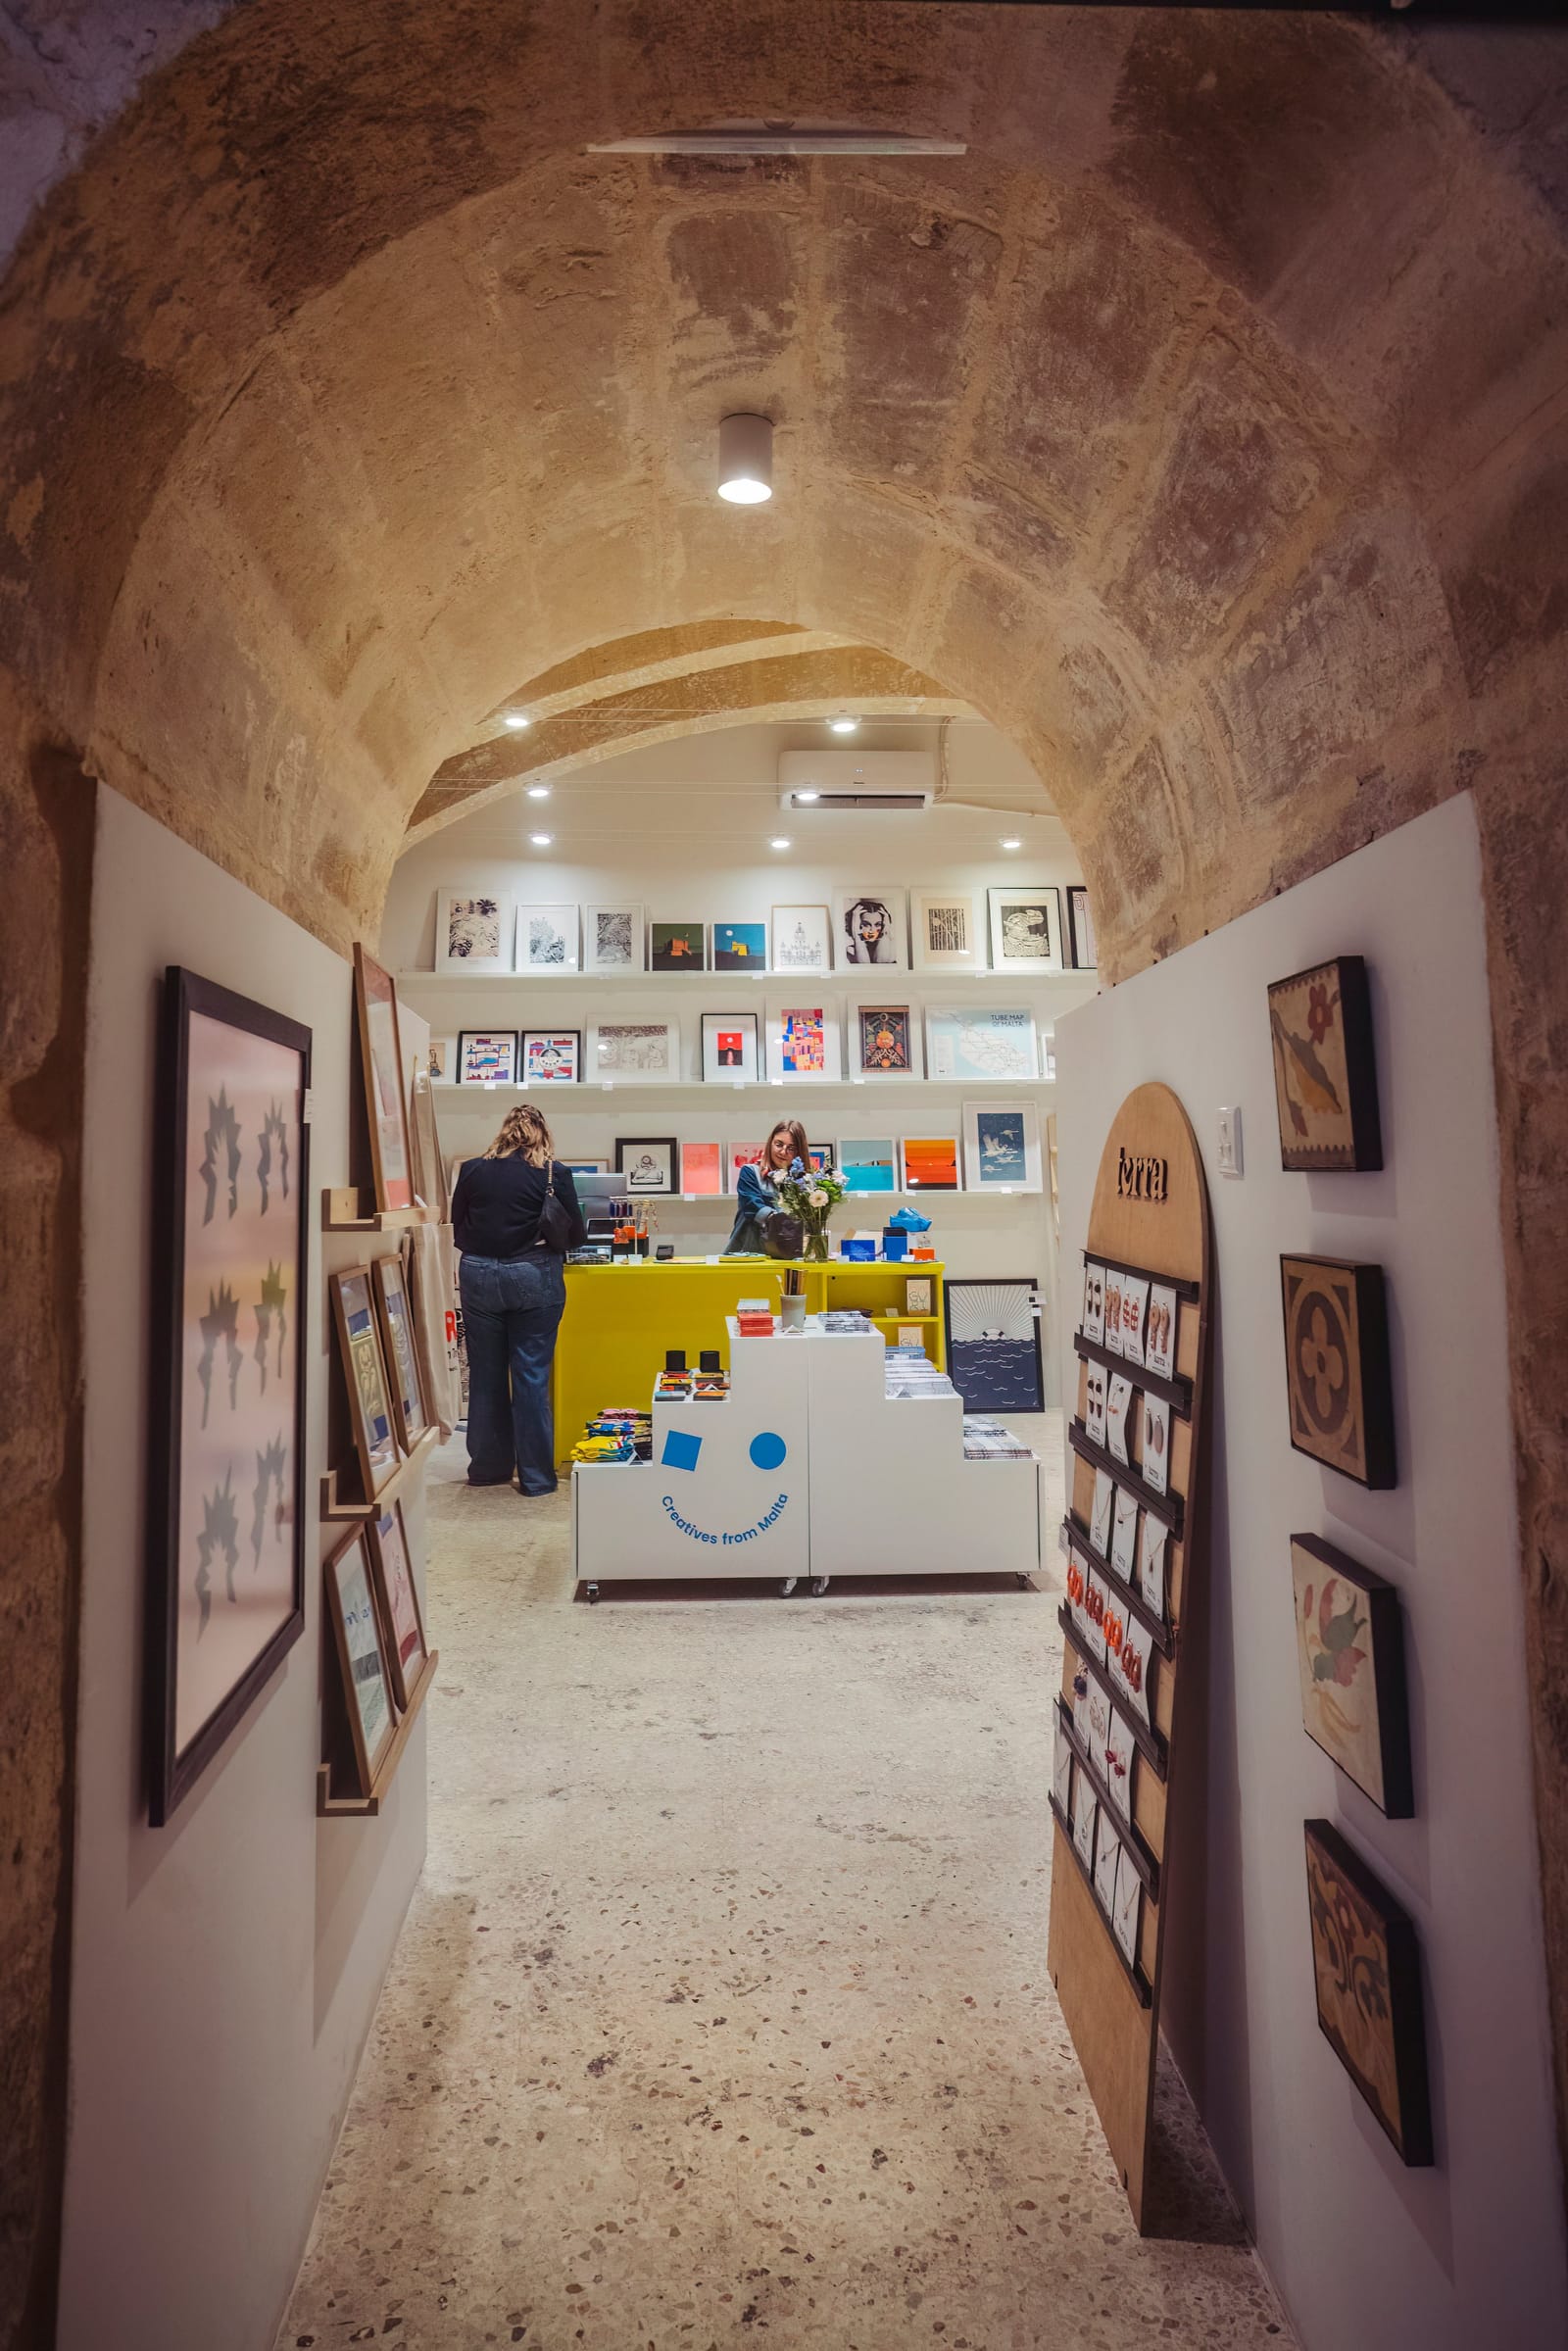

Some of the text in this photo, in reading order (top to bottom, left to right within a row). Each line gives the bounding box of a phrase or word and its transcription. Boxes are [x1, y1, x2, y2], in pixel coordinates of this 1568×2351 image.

[1117, 1147, 1168, 1200] terra
[662, 1493, 789, 1545] Creatives from Malta
